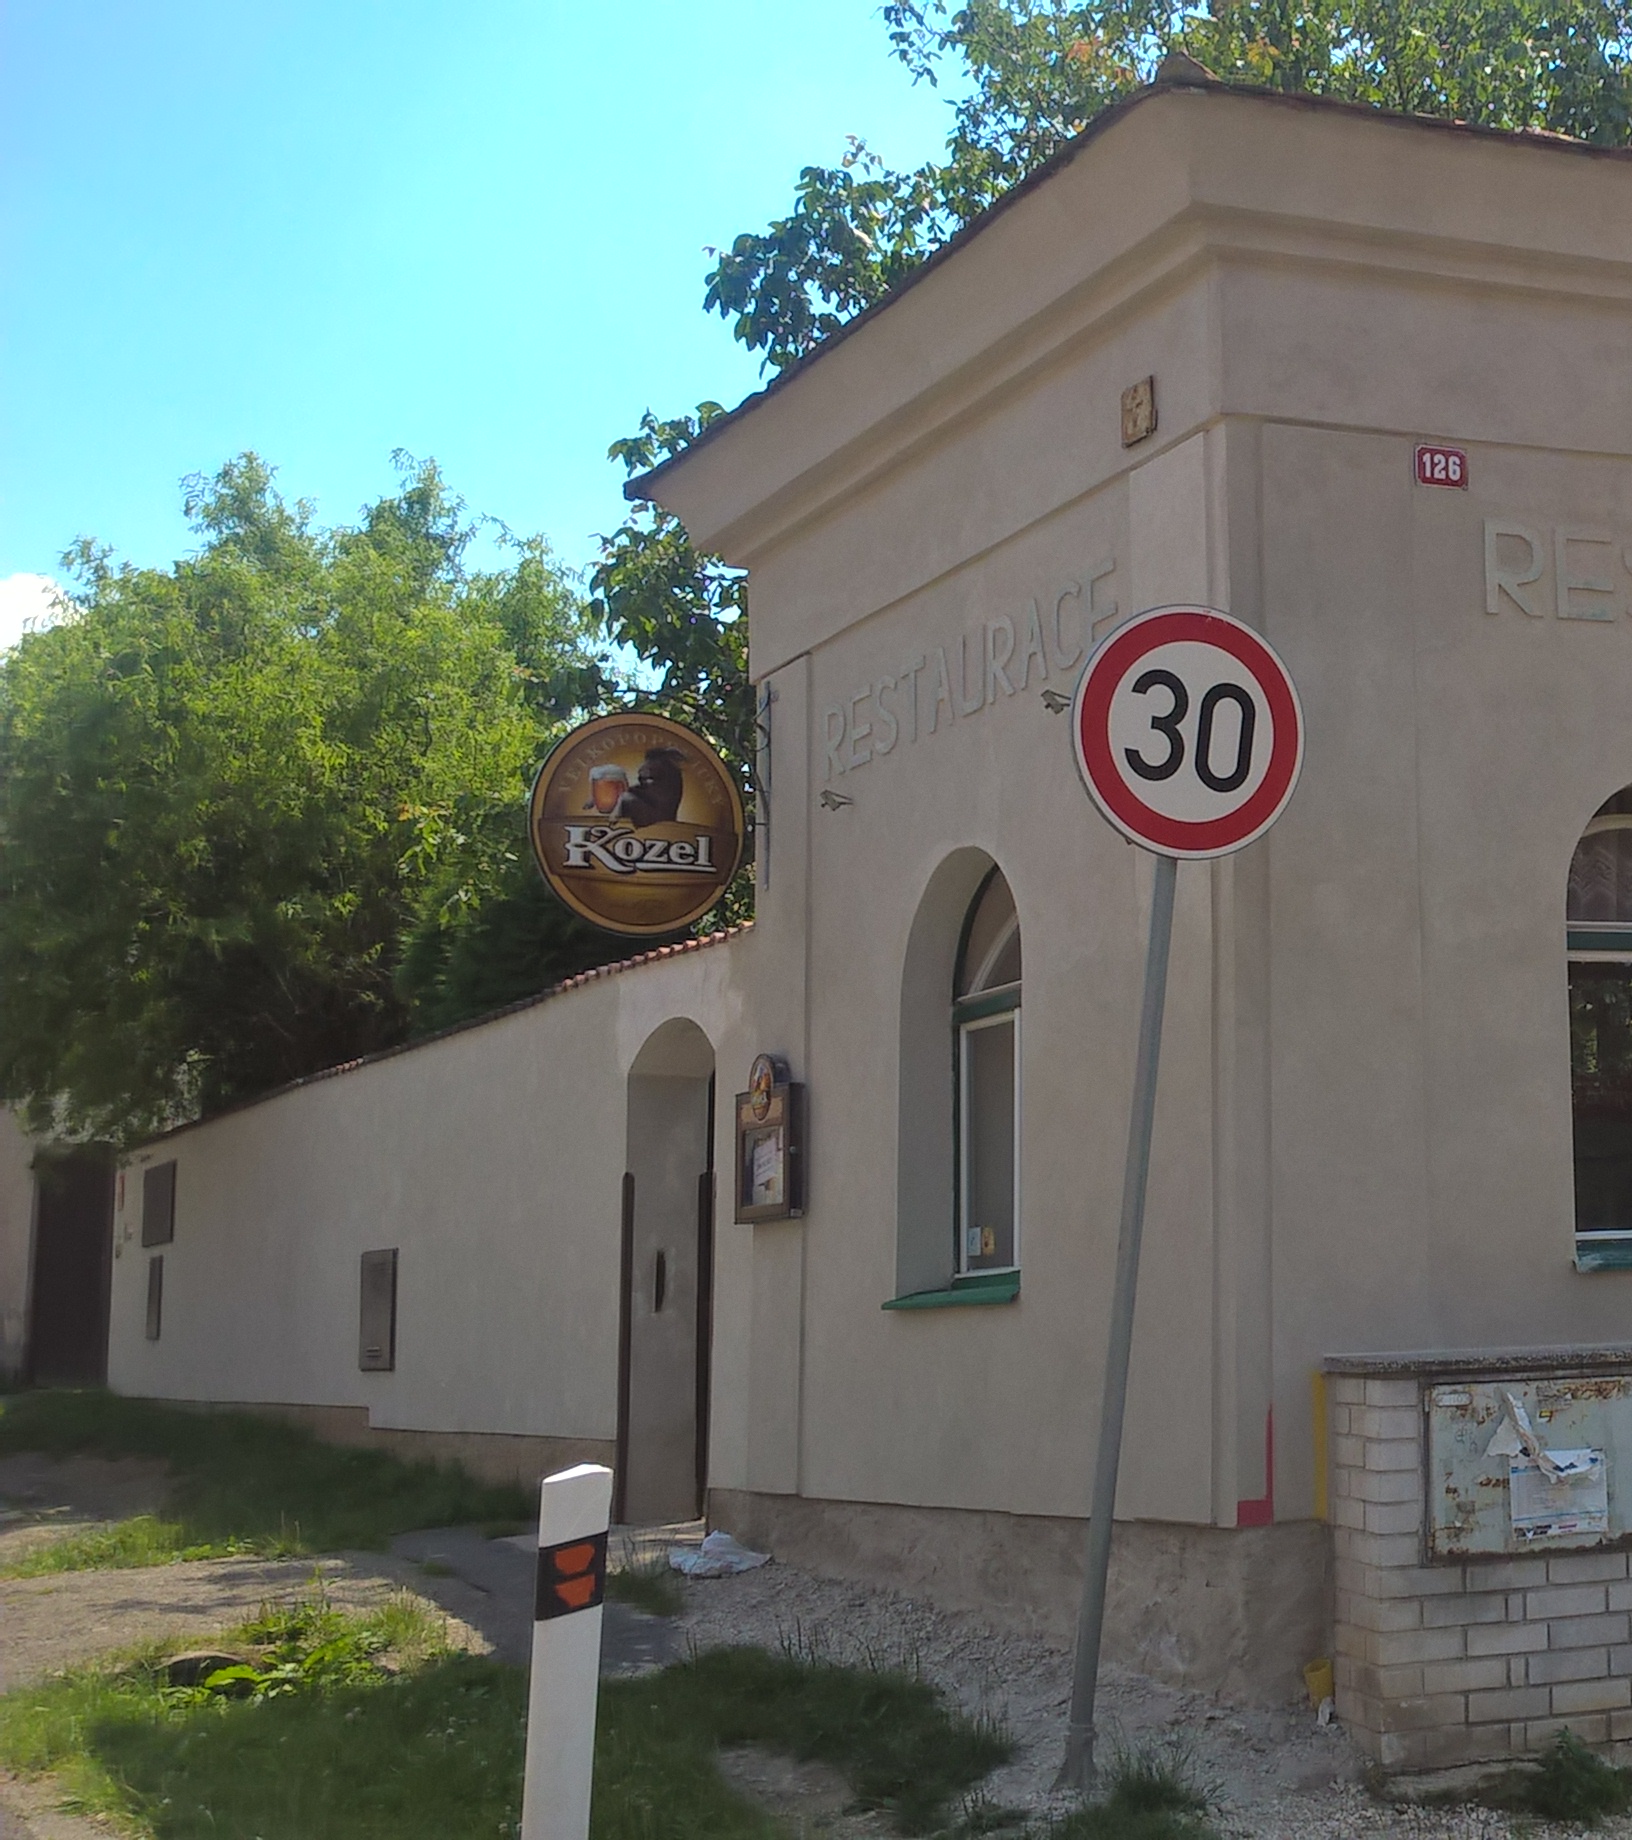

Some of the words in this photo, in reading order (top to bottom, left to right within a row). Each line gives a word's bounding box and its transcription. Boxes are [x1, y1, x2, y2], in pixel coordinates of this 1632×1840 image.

[1422, 453, 1462, 482] 126
[822, 557, 1119, 782] RESTAURACE
[1124, 669, 1256, 793] 30
[563, 825, 718, 874] Kozel
